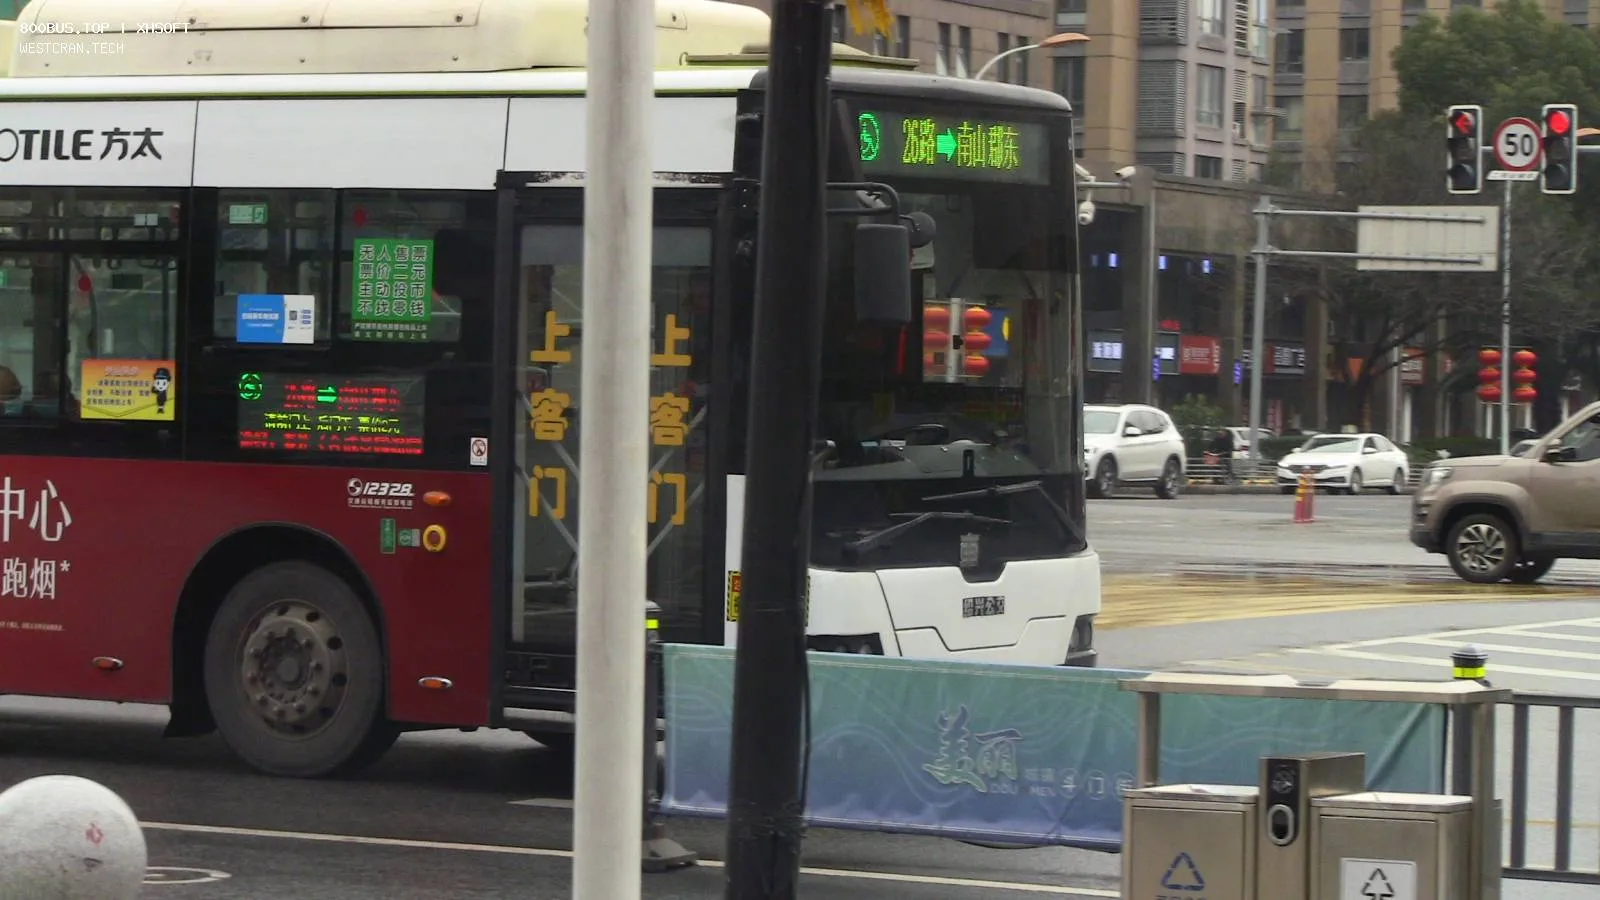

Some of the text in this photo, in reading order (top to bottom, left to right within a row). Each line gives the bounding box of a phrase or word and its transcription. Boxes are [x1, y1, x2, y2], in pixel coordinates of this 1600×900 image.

[100, 127, 164, 161] 方太
[902, 118, 935, 165] 26路
[1505, 133, 1534, 157] 50
[359, 244, 428, 262] 无人售票
[359, 262, 426, 280] 票价二元
[358, 281, 426, 299] 主动投币
[357, 299, 425, 317] 不找零钱
[362, 482, 415, 497] 12328
[0, 476, 73, 542] 中心
